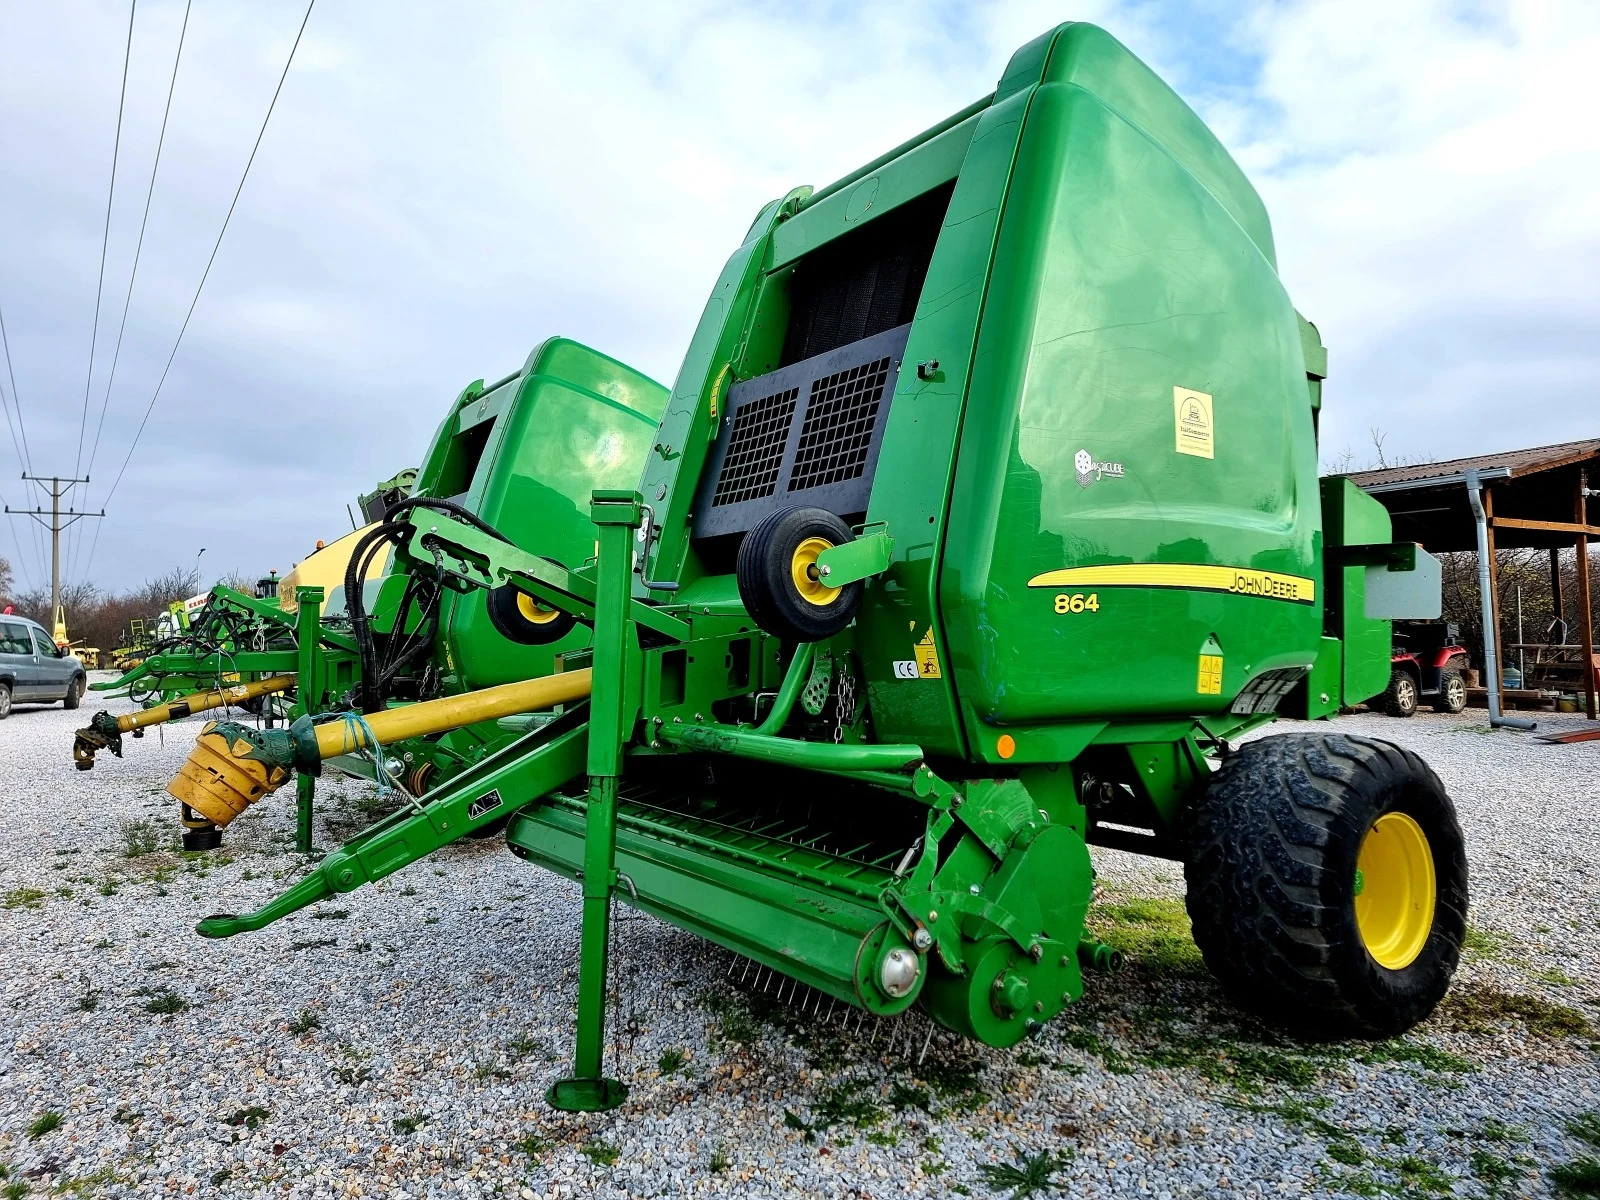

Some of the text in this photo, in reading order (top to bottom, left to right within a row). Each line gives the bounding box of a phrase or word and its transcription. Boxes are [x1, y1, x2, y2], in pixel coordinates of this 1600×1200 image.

[1229, 572, 1298, 598] JOHN DEERE
[1054, 593, 1100, 614] 864
[899, 662, 915, 677] CE
